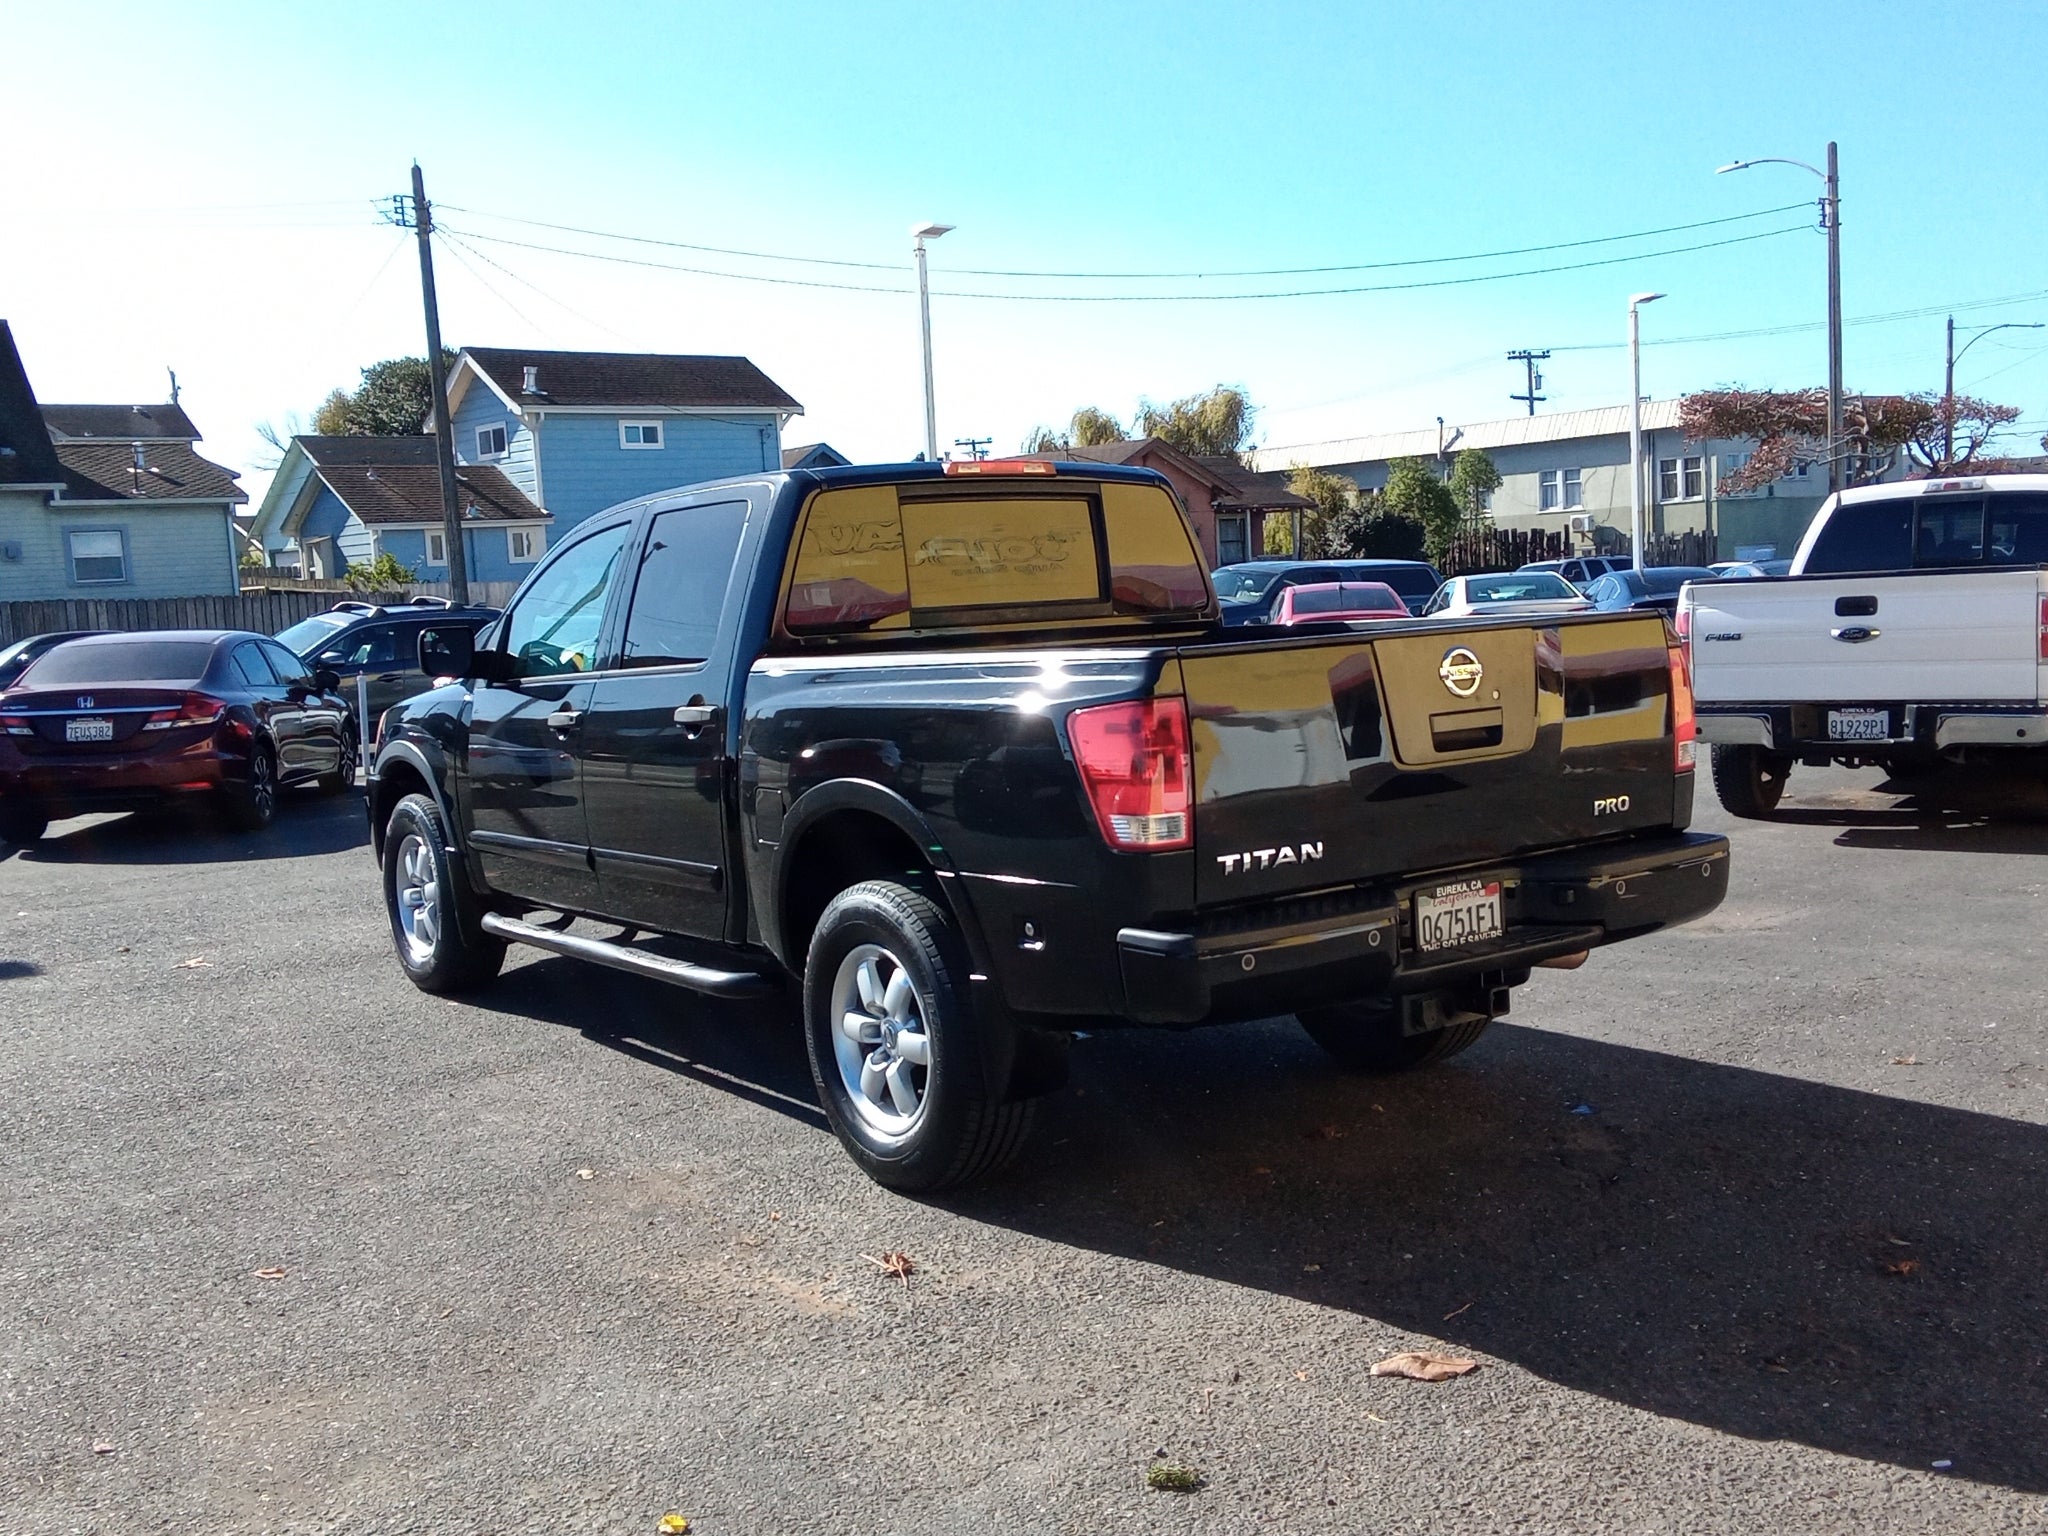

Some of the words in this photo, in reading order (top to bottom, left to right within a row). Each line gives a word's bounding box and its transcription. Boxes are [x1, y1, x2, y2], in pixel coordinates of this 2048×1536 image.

[1831, 720, 1885, 735] 81929P1
[1593, 795, 1630, 816] PRO
[1216, 841, 1324, 876] TITAN
[1436, 883, 1469, 897] EUREKA,
[1471, 880, 1482, 890] CA
[1422, 901, 1499, 944] 06751F1
